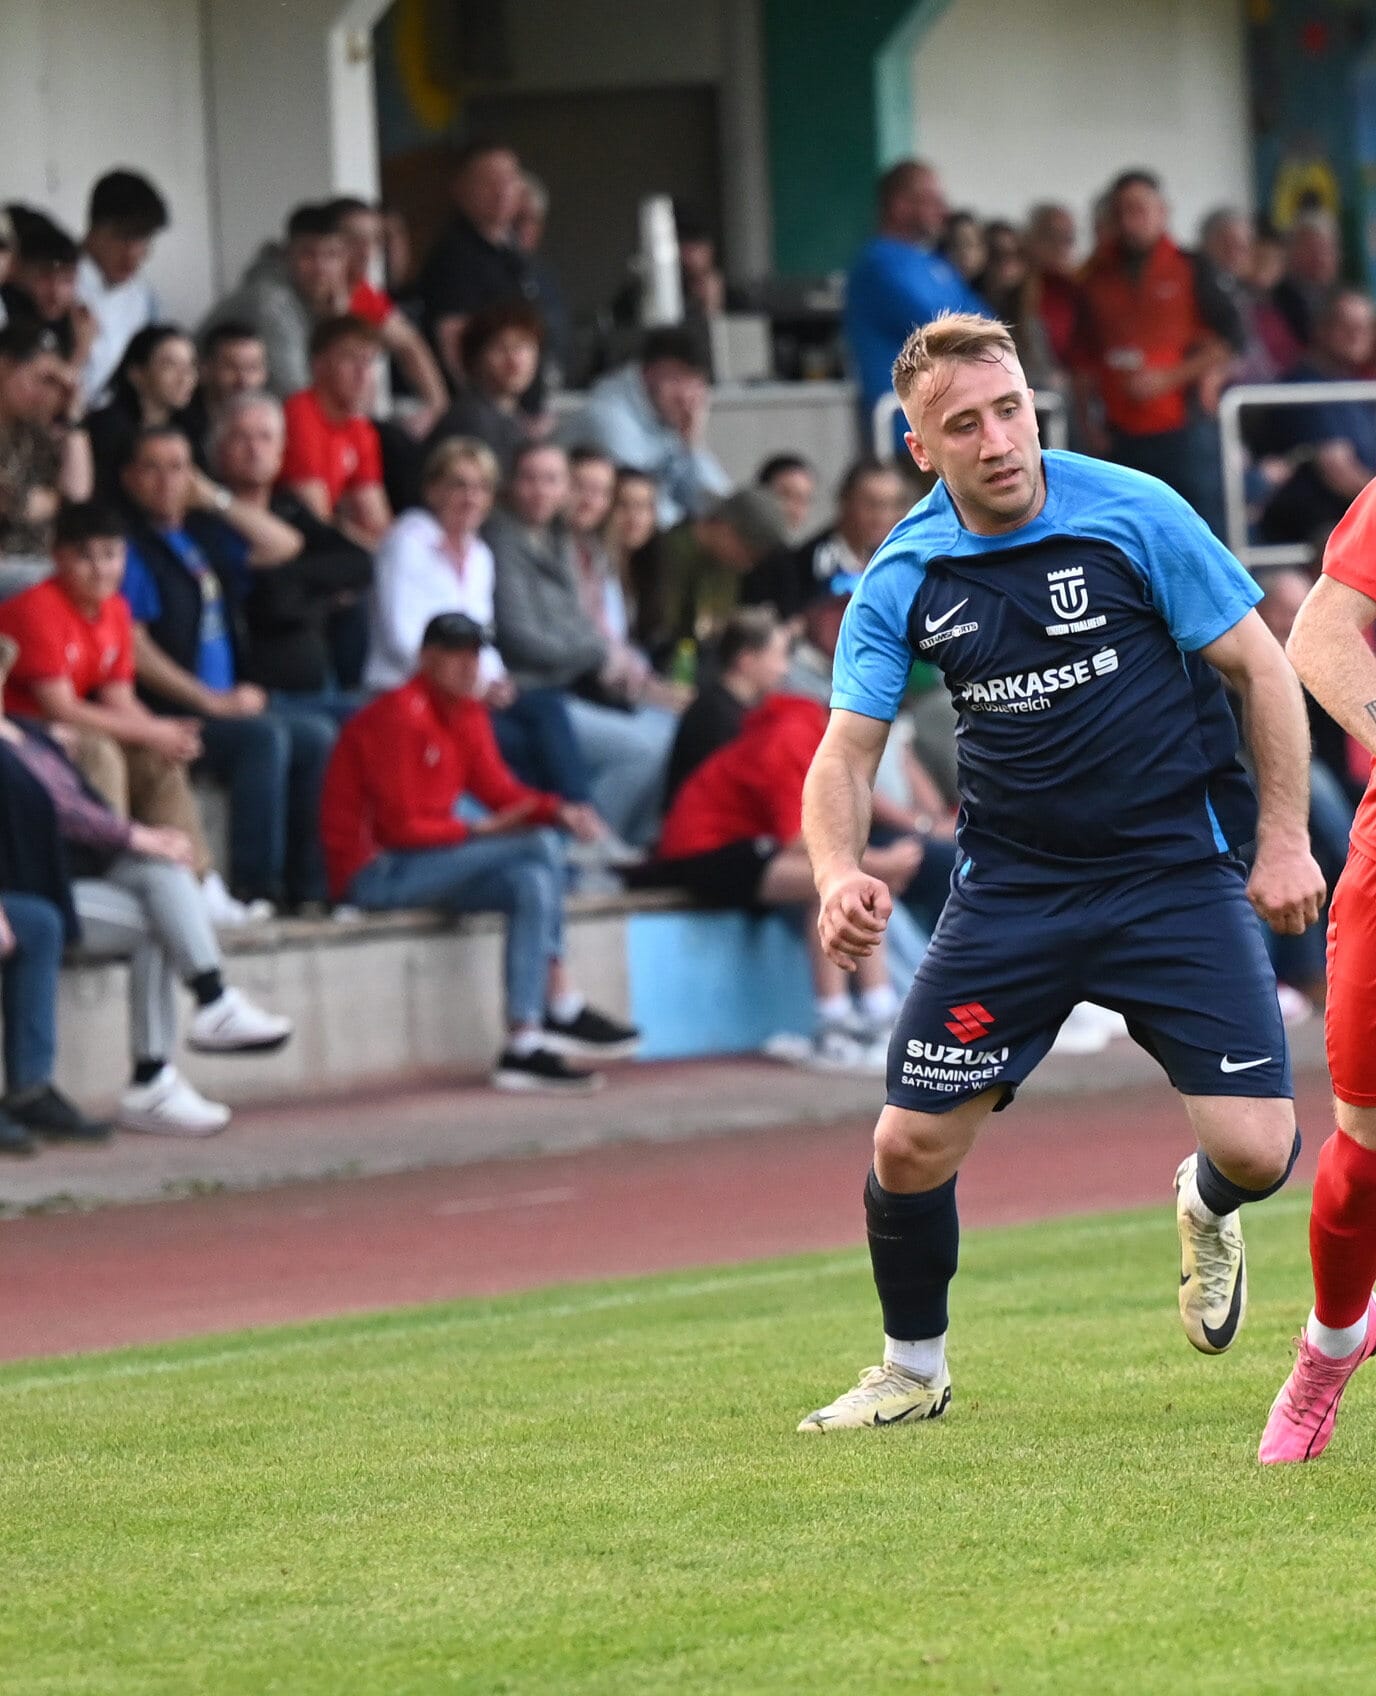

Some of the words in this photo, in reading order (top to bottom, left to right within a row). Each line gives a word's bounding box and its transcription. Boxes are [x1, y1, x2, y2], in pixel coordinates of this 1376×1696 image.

[955, 660, 1092, 703] ARKASSE
[906, 1039, 1009, 1065] SUZUKI
[901, 1075, 961, 1093] SATTLEDT
